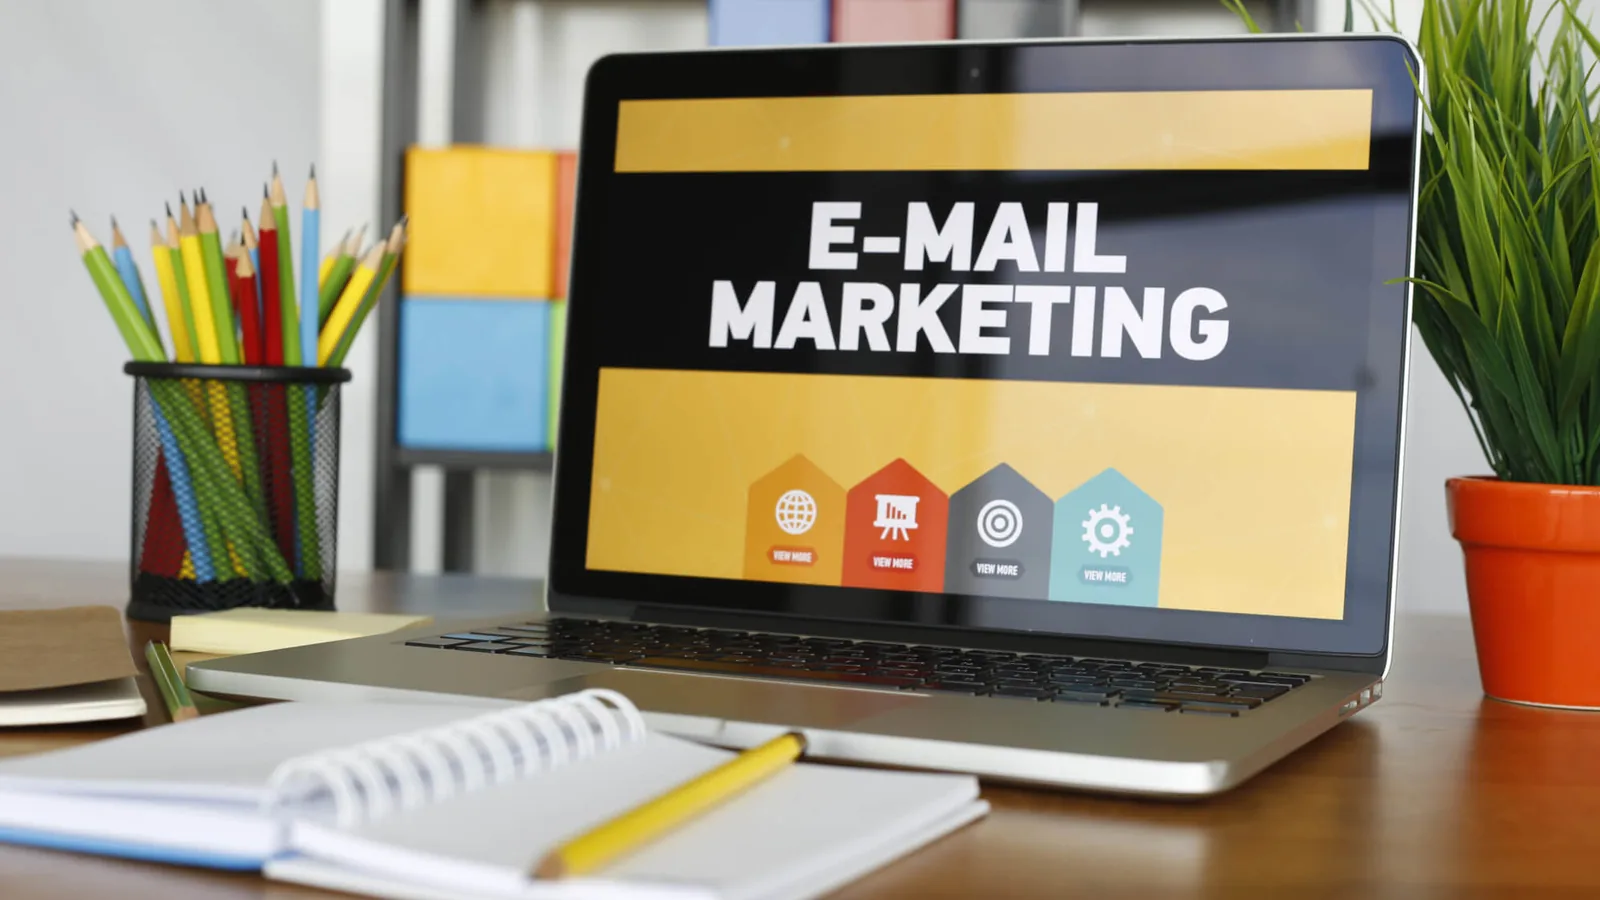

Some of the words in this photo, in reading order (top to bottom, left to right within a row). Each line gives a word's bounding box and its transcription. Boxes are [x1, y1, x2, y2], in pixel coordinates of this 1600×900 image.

[808, 202, 1127, 273] E-MAIL
[709, 280, 1230, 361] MARKETING
[774, 550, 791, 561] VIEW
[791, 551, 811, 563] MORE
[873, 556, 891, 568] VIEW
[892, 557, 912, 569] MORE
[976, 563, 995, 575] VIEW
[996, 564, 1018, 576] MORE
[1084, 570, 1103, 581] VIEW
[1104, 571, 1127, 583] MORE
